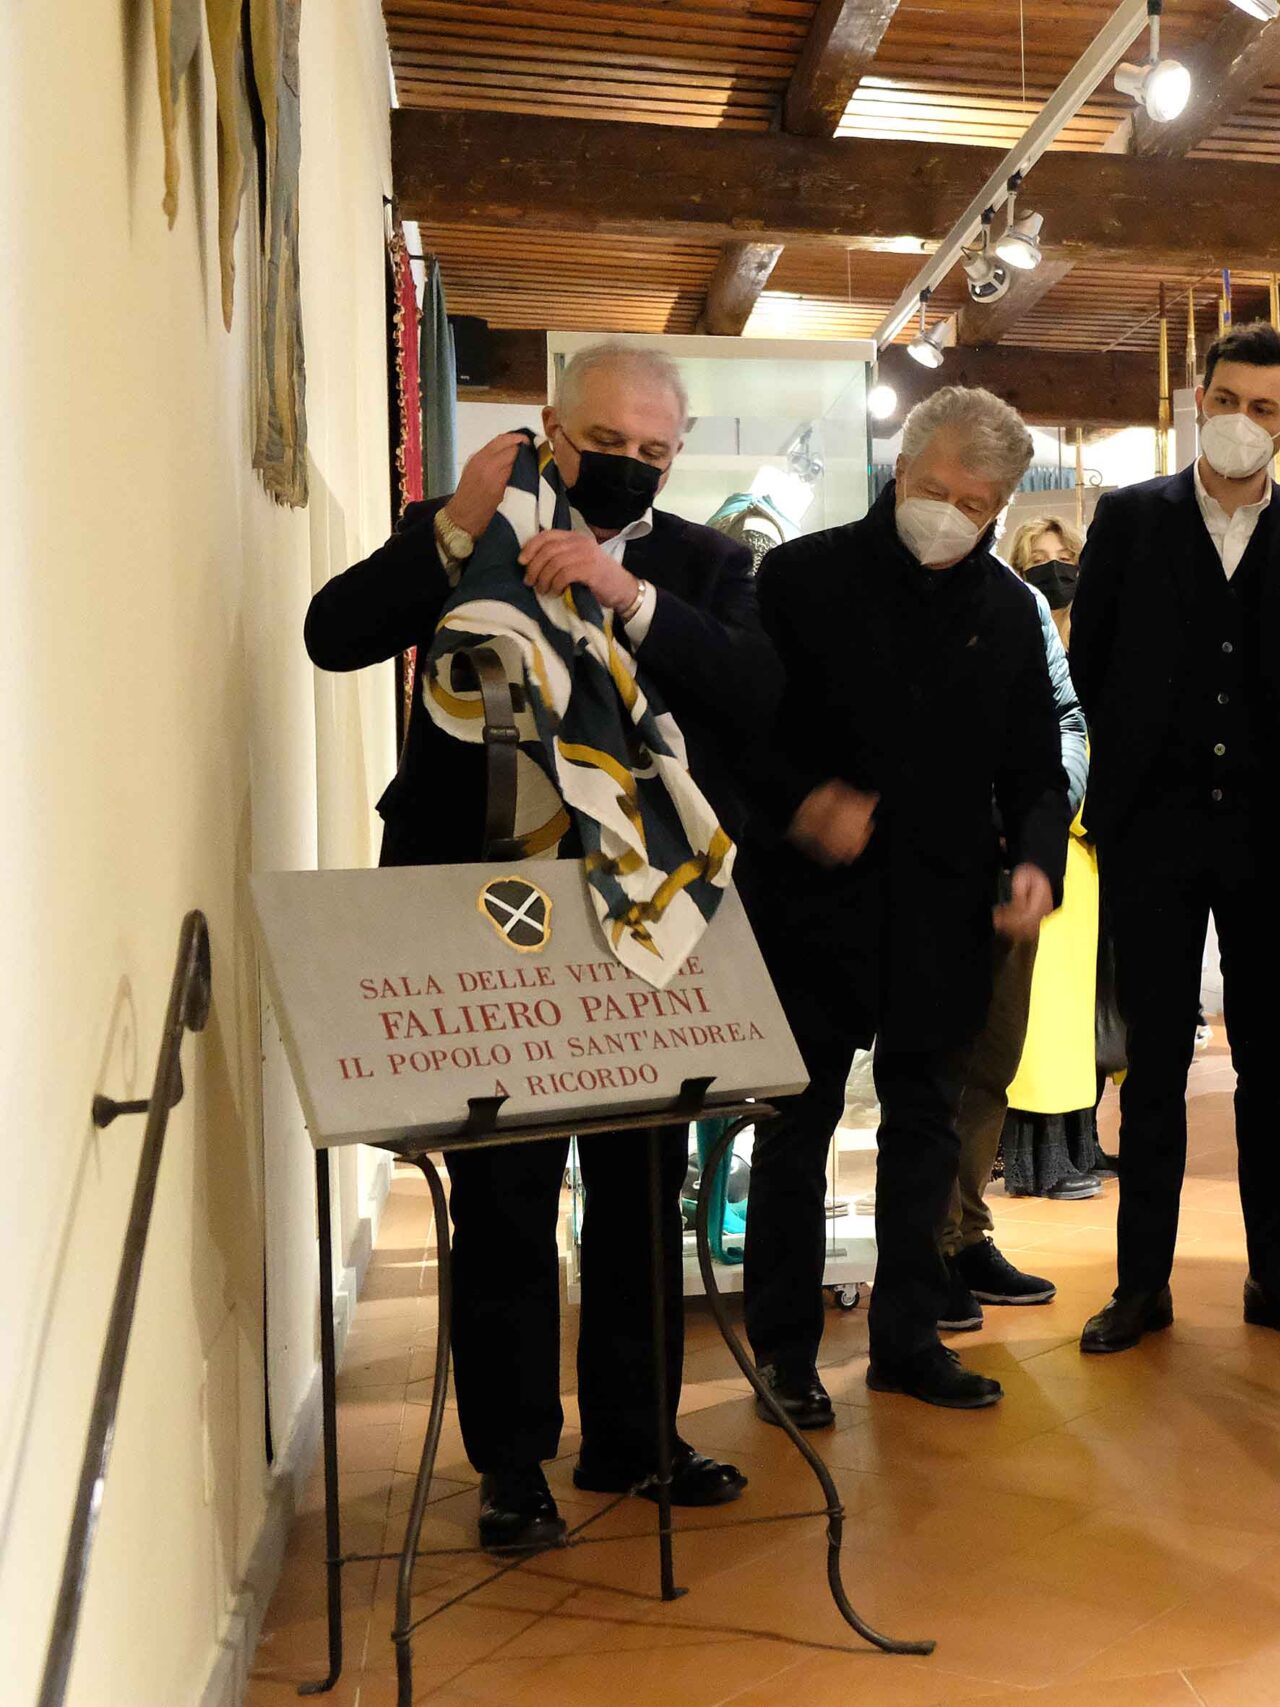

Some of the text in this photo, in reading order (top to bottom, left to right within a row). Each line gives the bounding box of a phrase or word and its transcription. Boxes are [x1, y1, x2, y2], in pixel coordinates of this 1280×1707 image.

[359, 974, 445, 999] SALA
[457, 966, 556, 992] DELLE
[378, 987, 712, 1040] FALIERO PAPINI
[337, 1021, 765, 1080] IL POPOLO DI SANT'ANDREA
[494, 1063, 659, 1097] A RICORDO
